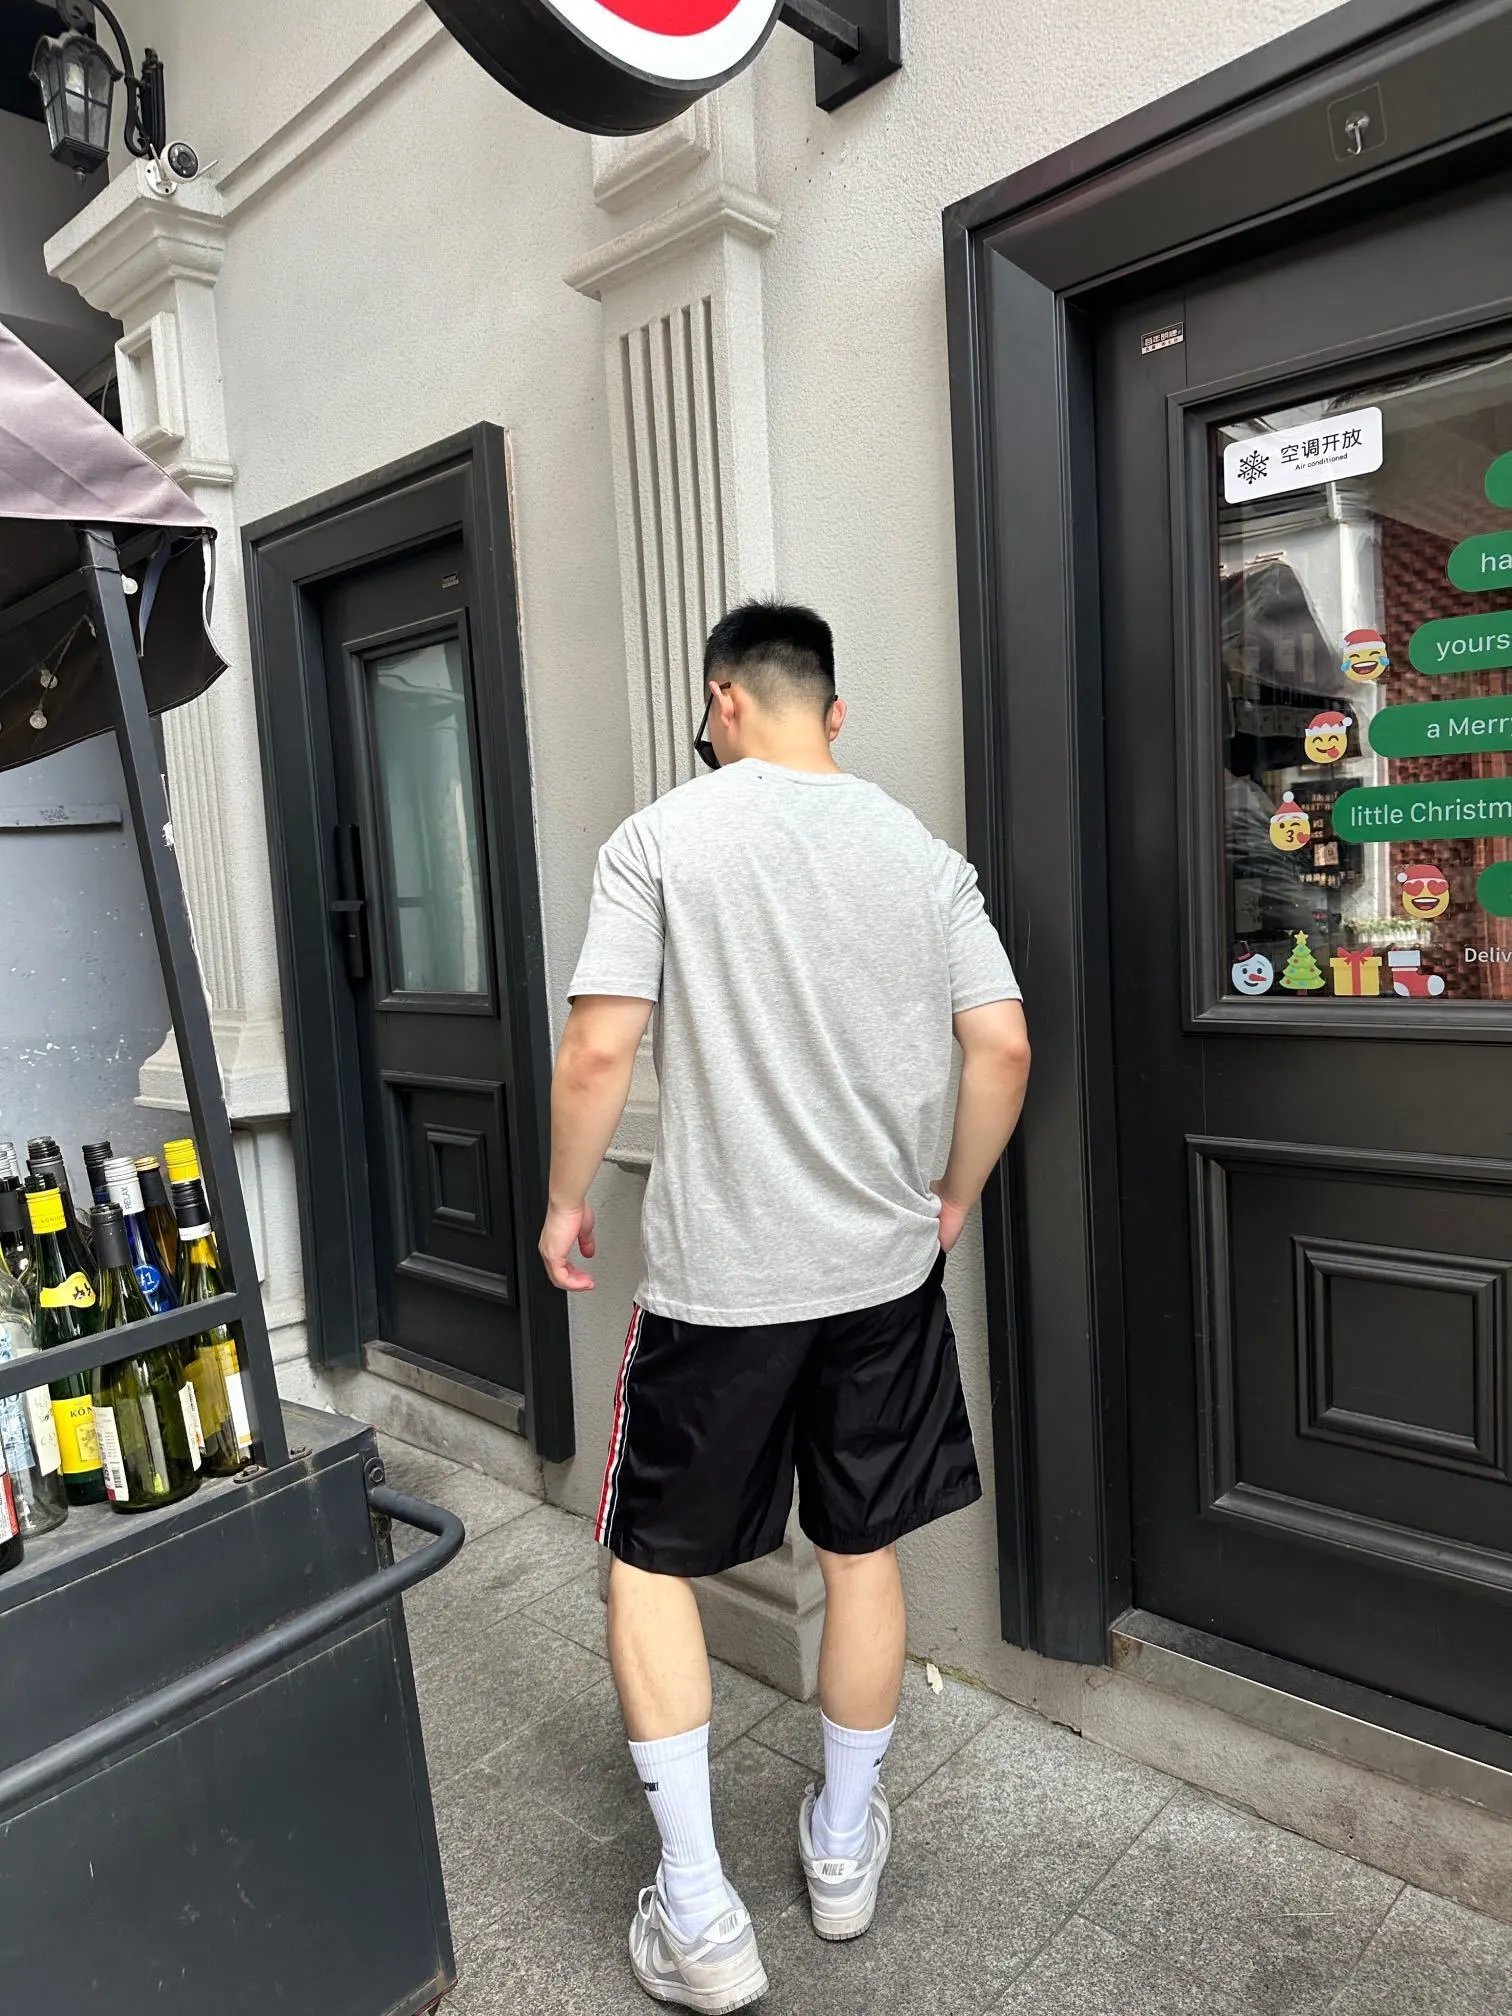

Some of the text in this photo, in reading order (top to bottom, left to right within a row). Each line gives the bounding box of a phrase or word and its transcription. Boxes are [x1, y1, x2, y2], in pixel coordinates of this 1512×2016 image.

[1280, 428, 1363, 464] 空调开放
[1295, 452, 1348, 471] Air conditioned
[1427, 717, 1512, 738] a Merr
[1351, 803, 1403, 827] little
[121, 1186, 133, 1210] RELAX
[821, 1863, 845, 1876] NIKE
